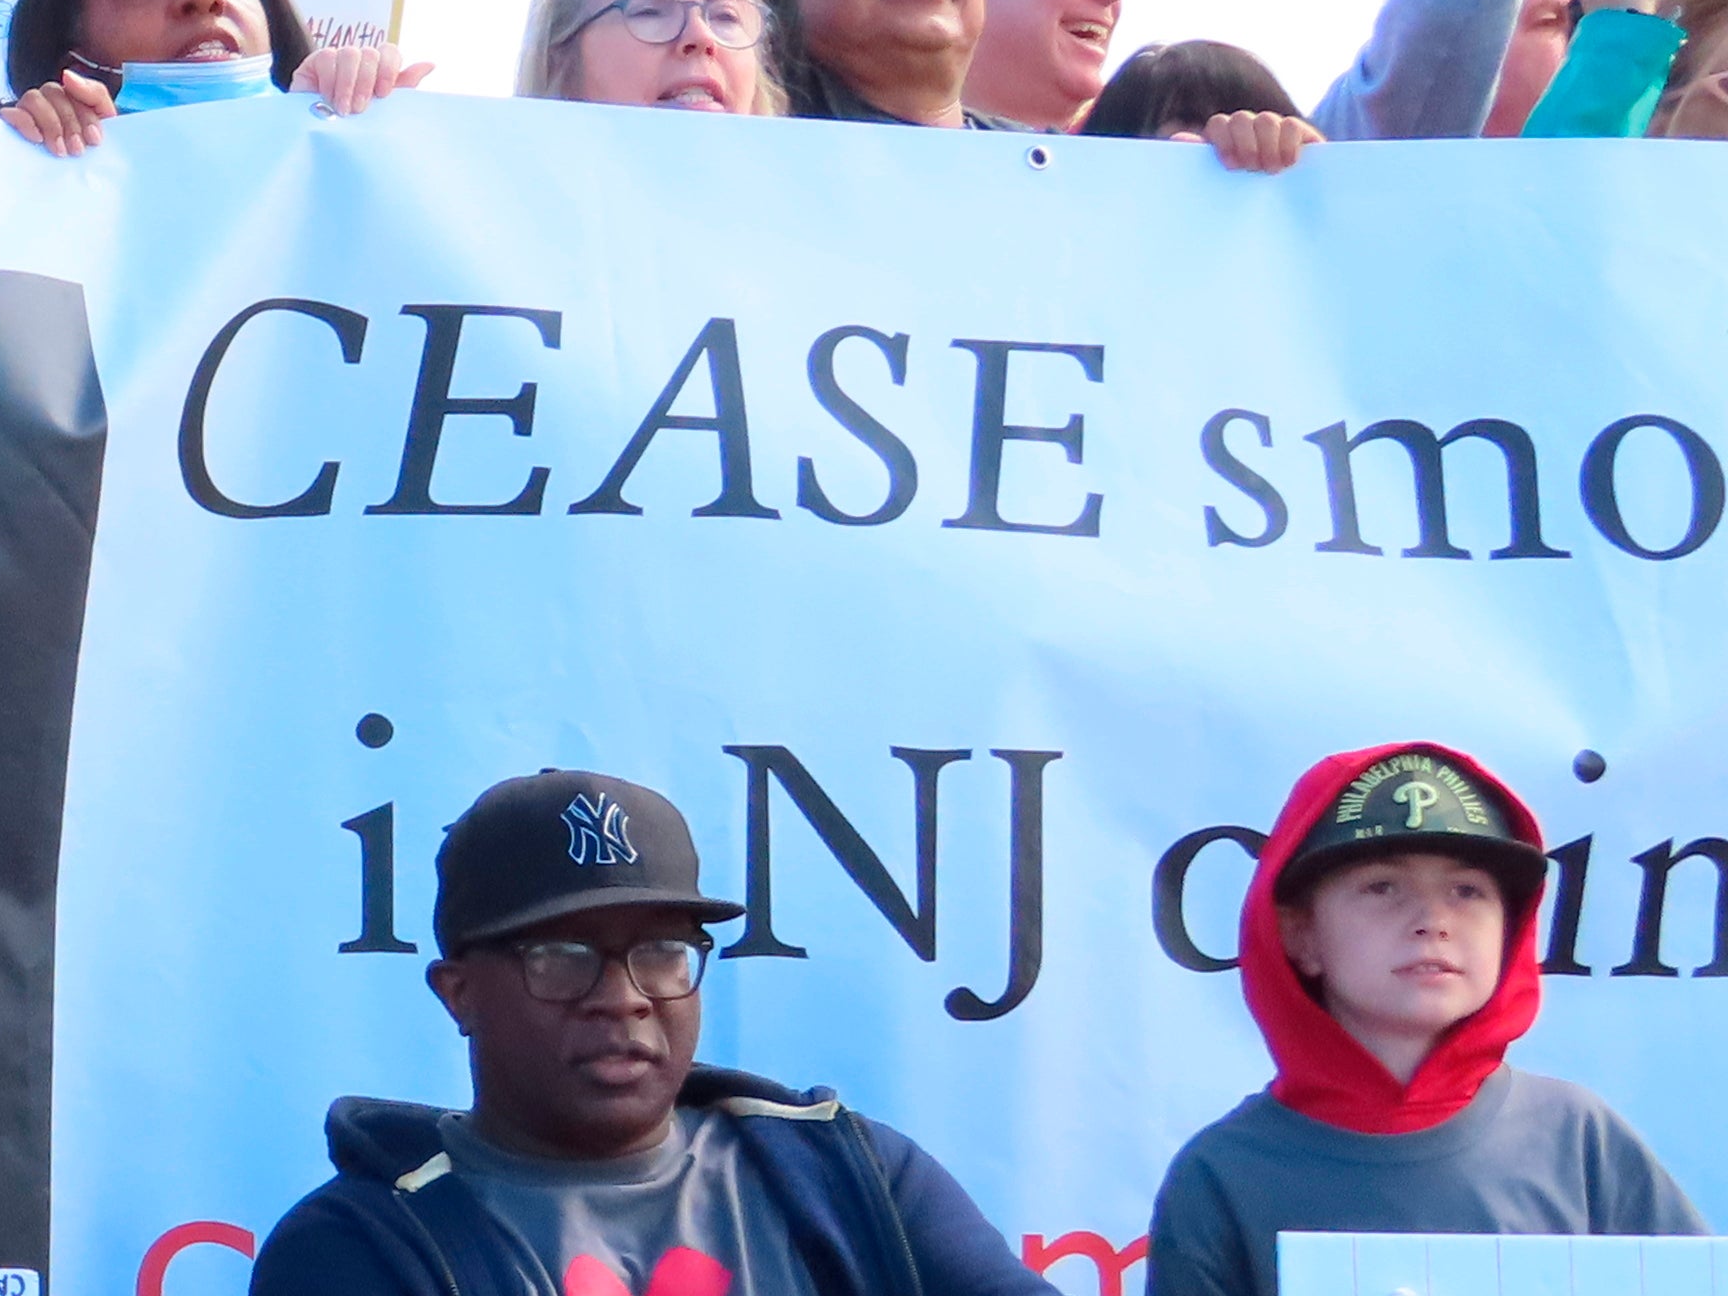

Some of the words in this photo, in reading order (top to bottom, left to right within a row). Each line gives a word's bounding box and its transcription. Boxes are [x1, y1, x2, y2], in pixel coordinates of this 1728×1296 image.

[175, 296, 1107, 537] CEASE
[719, 743, 1064, 1023] NJ
[1336, 755, 1432, 824] PHILADELPHIA
[1437, 765, 1489, 825] PHILLIES
